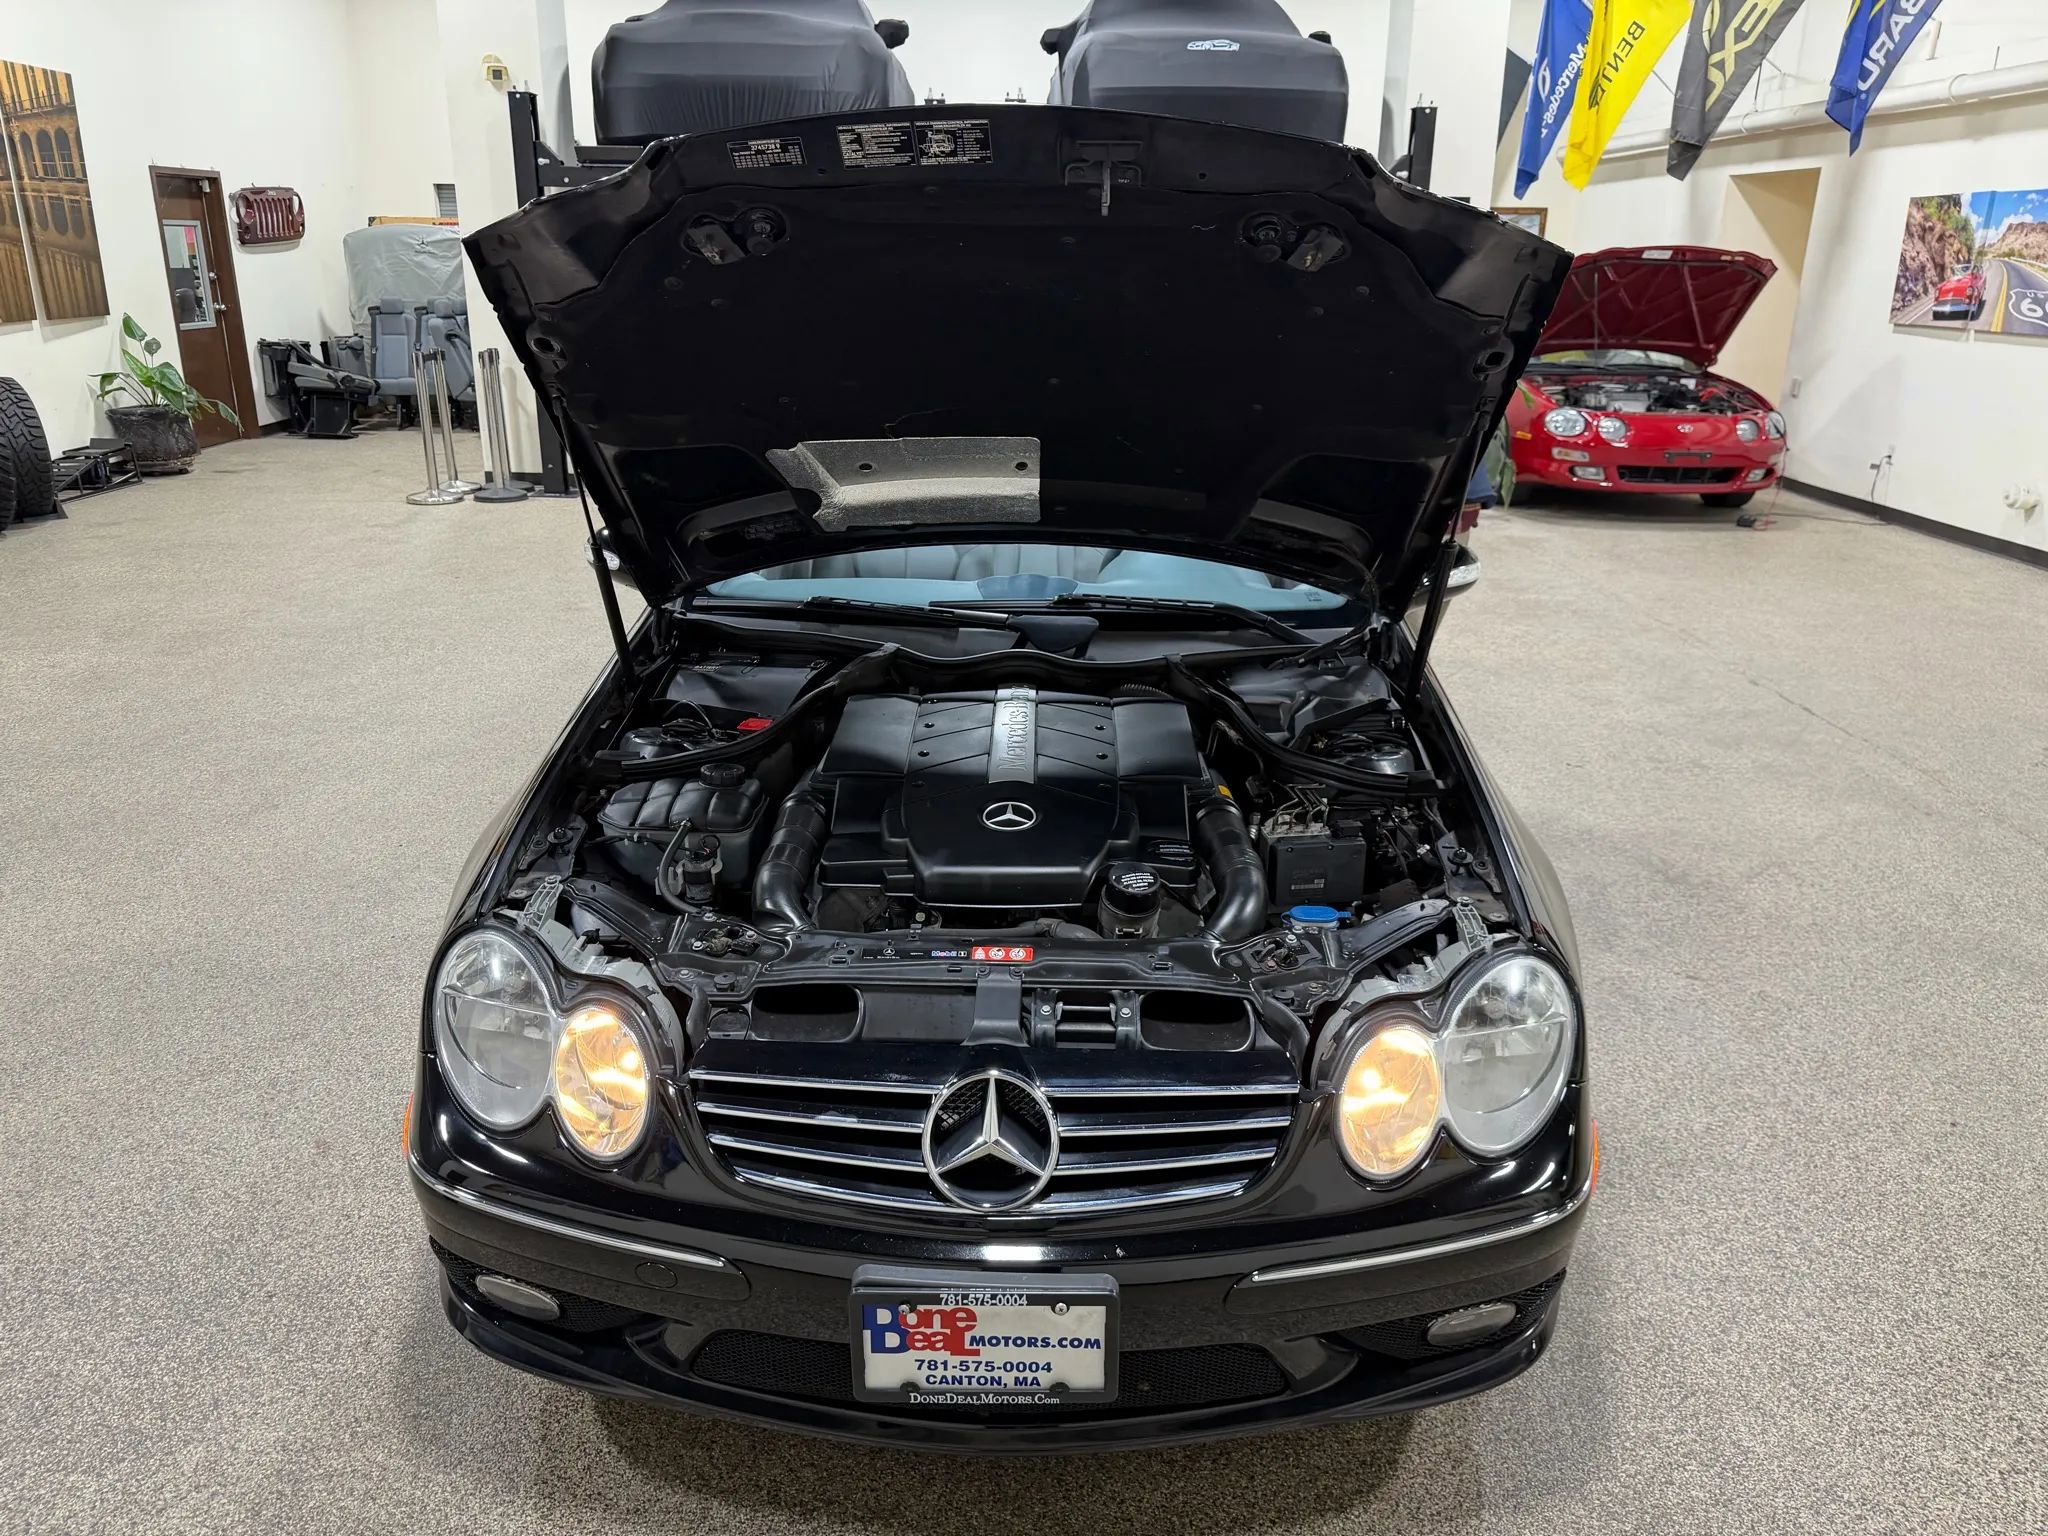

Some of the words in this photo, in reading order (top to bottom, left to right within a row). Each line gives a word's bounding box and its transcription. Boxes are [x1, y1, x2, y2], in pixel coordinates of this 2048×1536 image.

[2020, 298, 2048, 318] 6
[939, 1293, 1028, 1307] 781-575-0004
[968, 1334, 1102, 1350] MOTORS.COM
[914, 1358, 1053, 1373] 781-575-0004
[925, 1373, 1008, 1389] CANTON,
[1013, 1375, 1042, 1387] MA
